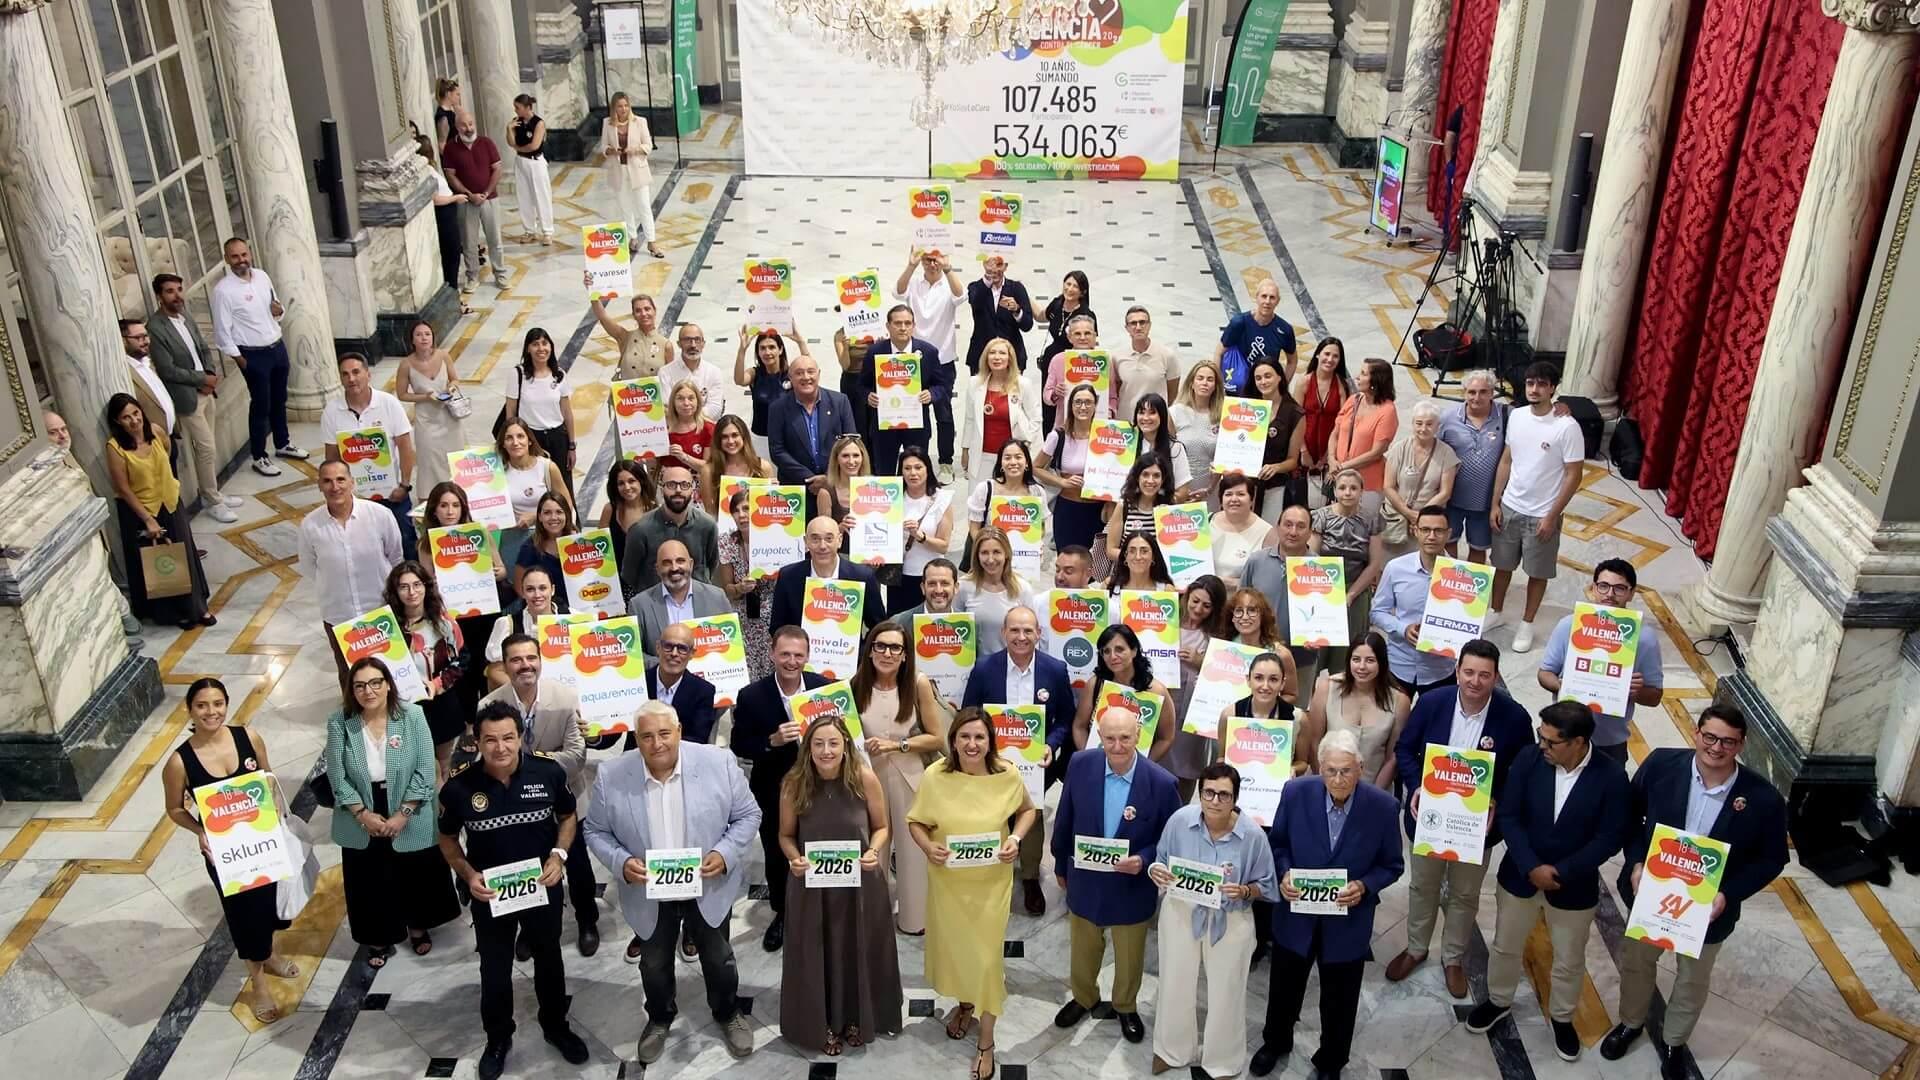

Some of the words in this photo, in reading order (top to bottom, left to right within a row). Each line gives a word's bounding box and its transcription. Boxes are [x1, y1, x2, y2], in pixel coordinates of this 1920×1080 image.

[1040, 61, 1049, 71] 10
[1052, 59, 1076, 71] AÑOS
[1036, 72, 1079, 83] SUMANDO
[1002, 85, 1096, 113] 107.485
[599, 269, 628, 278] vareser
[751, 275, 781, 283] VALENCIA
[1072, 365, 1101, 373] VALENCIA
[633, 426, 665, 436] mapfre
[1097, 436, 1128, 446] VALENCIA
[347, 444, 380, 454] VALENCIA
[758, 506, 794, 515] VALENCIA
[999, 514, 1032, 523] VALENCIA
[1165, 523, 1199, 534] VALENCIA
[440, 543, 478, 556] VALENCIA
[751, 546, 792, 558] grupotec
[568, 550, 603, 563] VALENCIA
[1296, 575, 1335, 585] VALENCIA
[1439, 577, 1480, 594] VALENCIA
[441, 579, 494, 594] cecotec
[582, 586, 609, 597] Dacsa
[813, 600, 850, 611] VALENCIA
[1058, 610, 1097, 620] VALENCIA
[1130, 610, 1168, 621] VALENCIA
[1426, 616, 1479, 635] FERMAX
[1581, 626, 1625, 641] VALENCIA
[350, 631, 390, 652] VALENCIA
[924, 636, 963, 645] VALENCIA
[583, 645, 628, 658] VALENCIA
[1067, 648, 1088, 657] REX
[707, 667, 745, 677] Levantina
[581, 686, 645, 704] aquaservice
[1237, 741, 1279, 752] VALENCIA
[1434, 769, 1478, 785] VALENCIA
[212, 800, 258, 818] VALENCIA
[221, 838, 278, 864] sklum
[955, 847, 993, 860] 2026
[1083, 849, 1121, 866] 2026
[1659, 851, 1708, 875] VALENCIA
[814, 858, 853, 874] 2026
[655, 867, 694, 885] 2026
[498, 877, 537, 902] 2026
[1175, 874, 1216, 895] 2026
[1299, 886, 1340, 902] 2026
